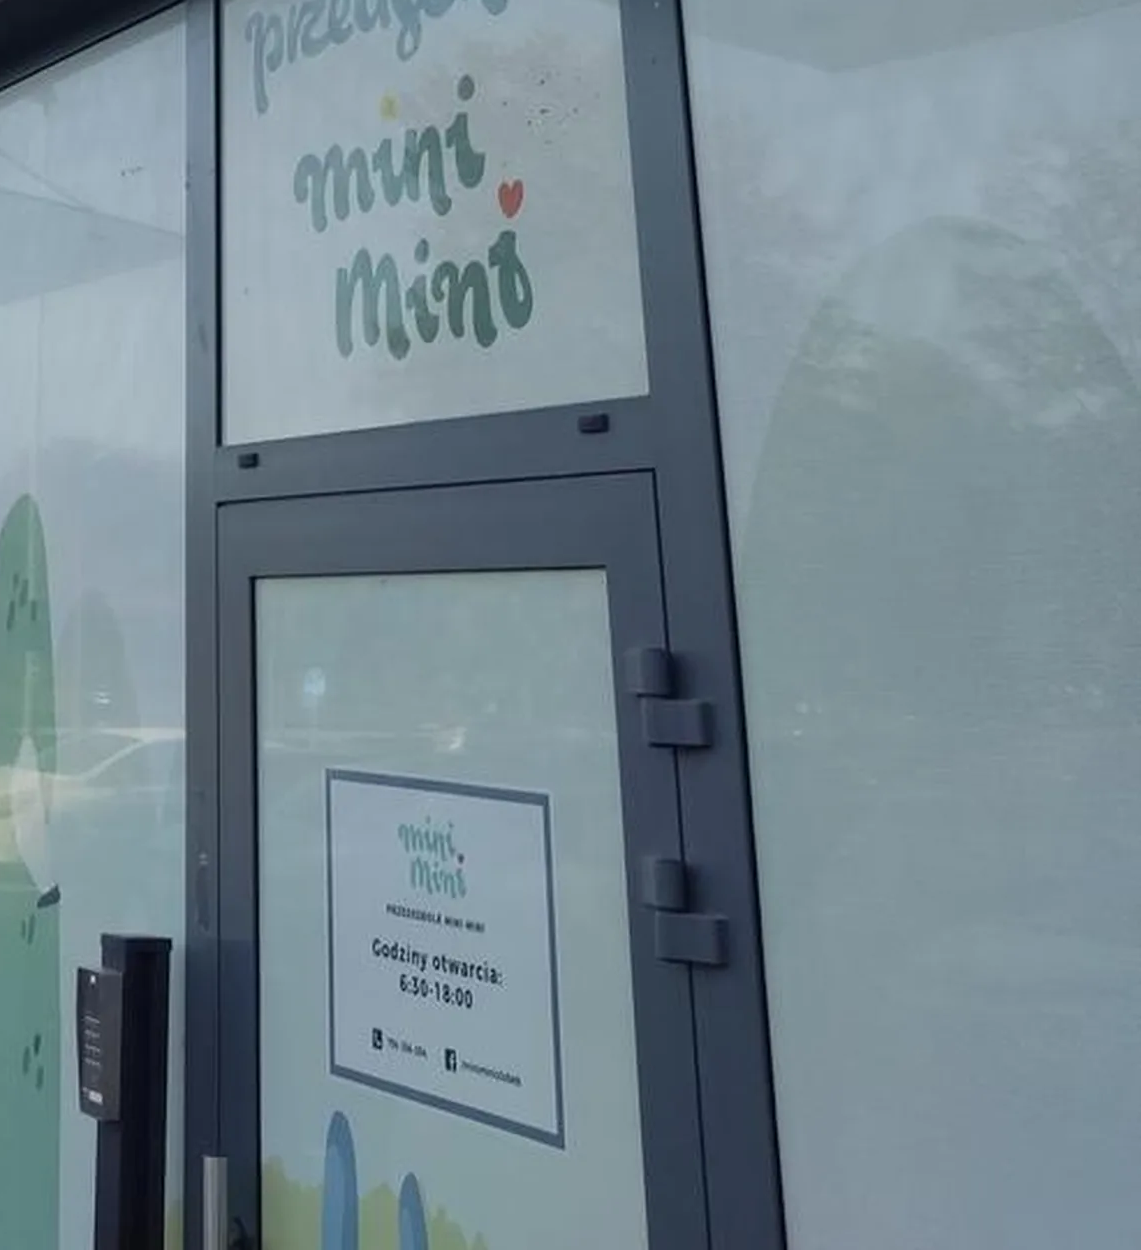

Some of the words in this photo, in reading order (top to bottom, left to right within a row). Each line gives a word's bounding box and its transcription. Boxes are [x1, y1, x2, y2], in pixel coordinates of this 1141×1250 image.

[293, 73, 486, 232] mini
[372, 938, 427, 972] Godziny
[432, 953, 504, 986] otwarcia:
[400, 973, 473, 1009] 6:30-18:00
